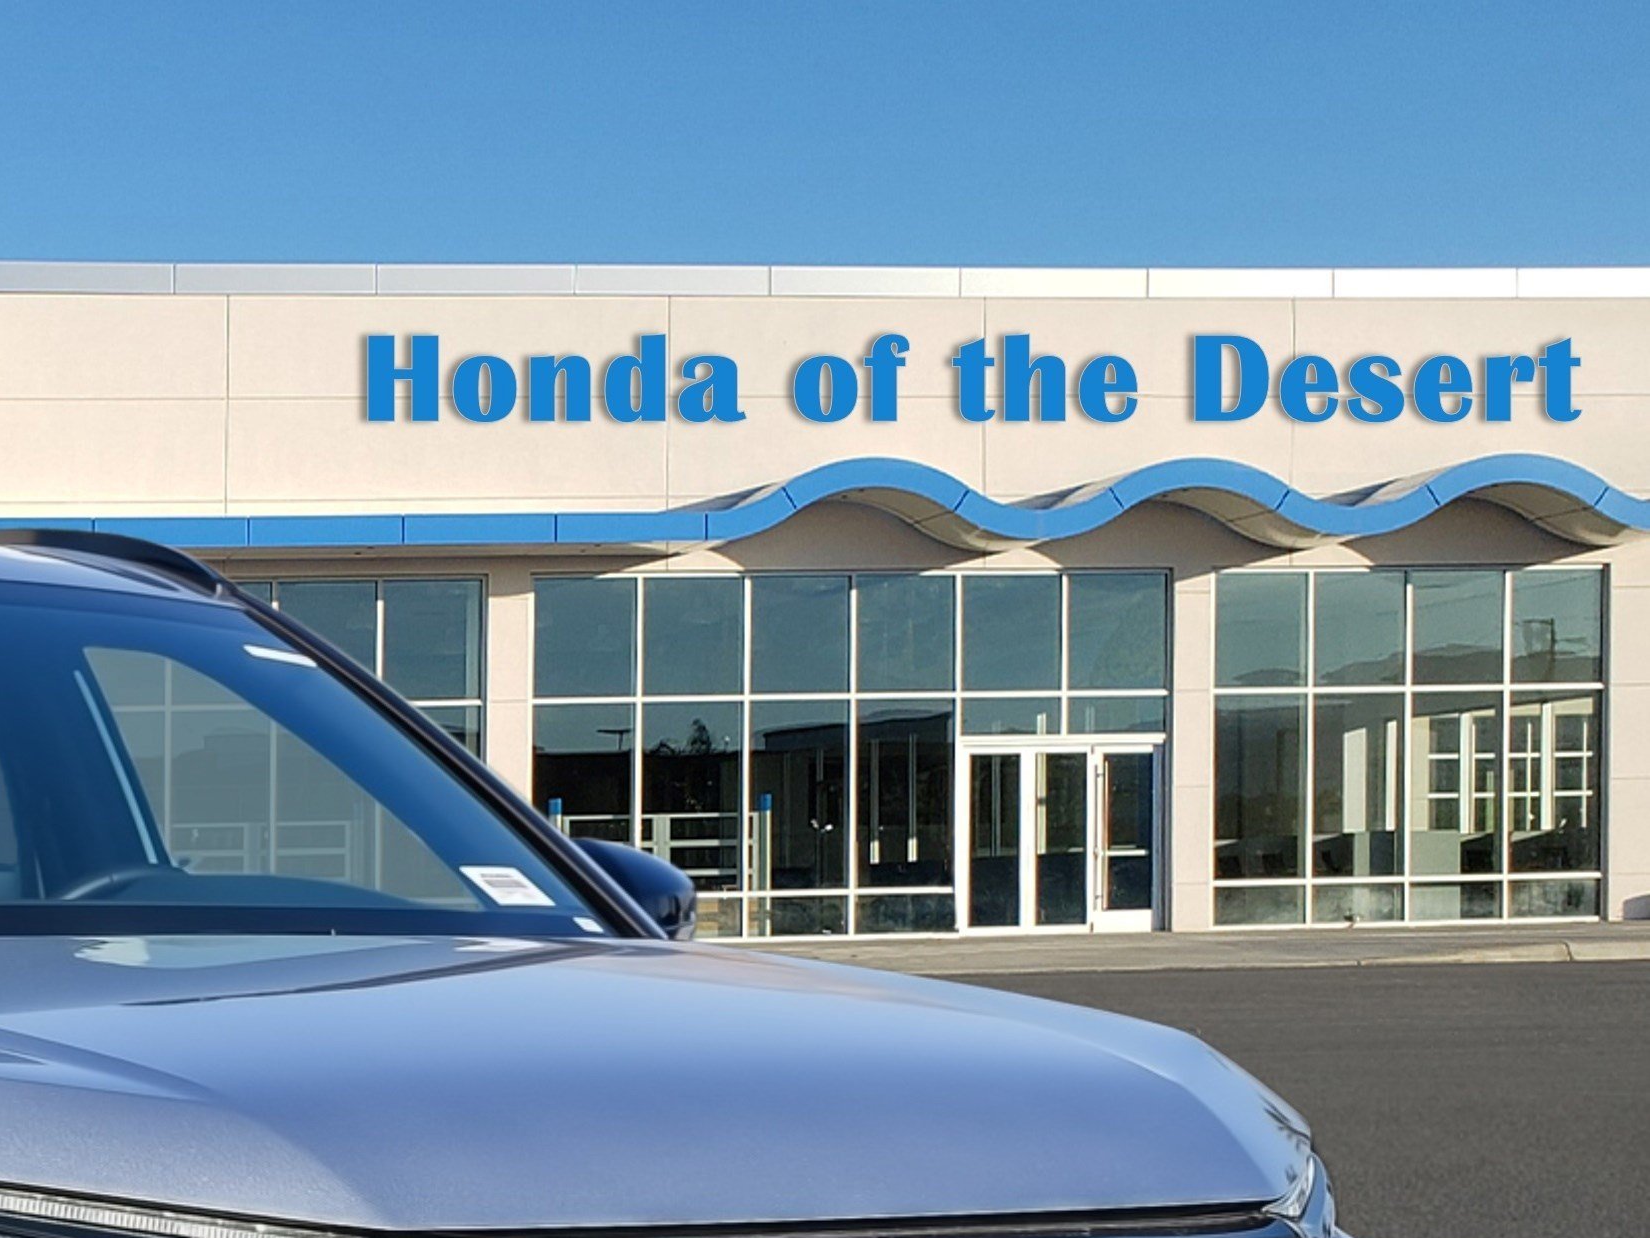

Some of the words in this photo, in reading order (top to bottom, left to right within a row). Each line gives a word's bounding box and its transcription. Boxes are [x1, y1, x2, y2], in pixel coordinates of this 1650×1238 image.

[364, 333, 747, 423] Honda
[794, 333, 911, 423] of
[952, 333, 1138, 423] the
[1193, 334, 1583, 423] Desert
